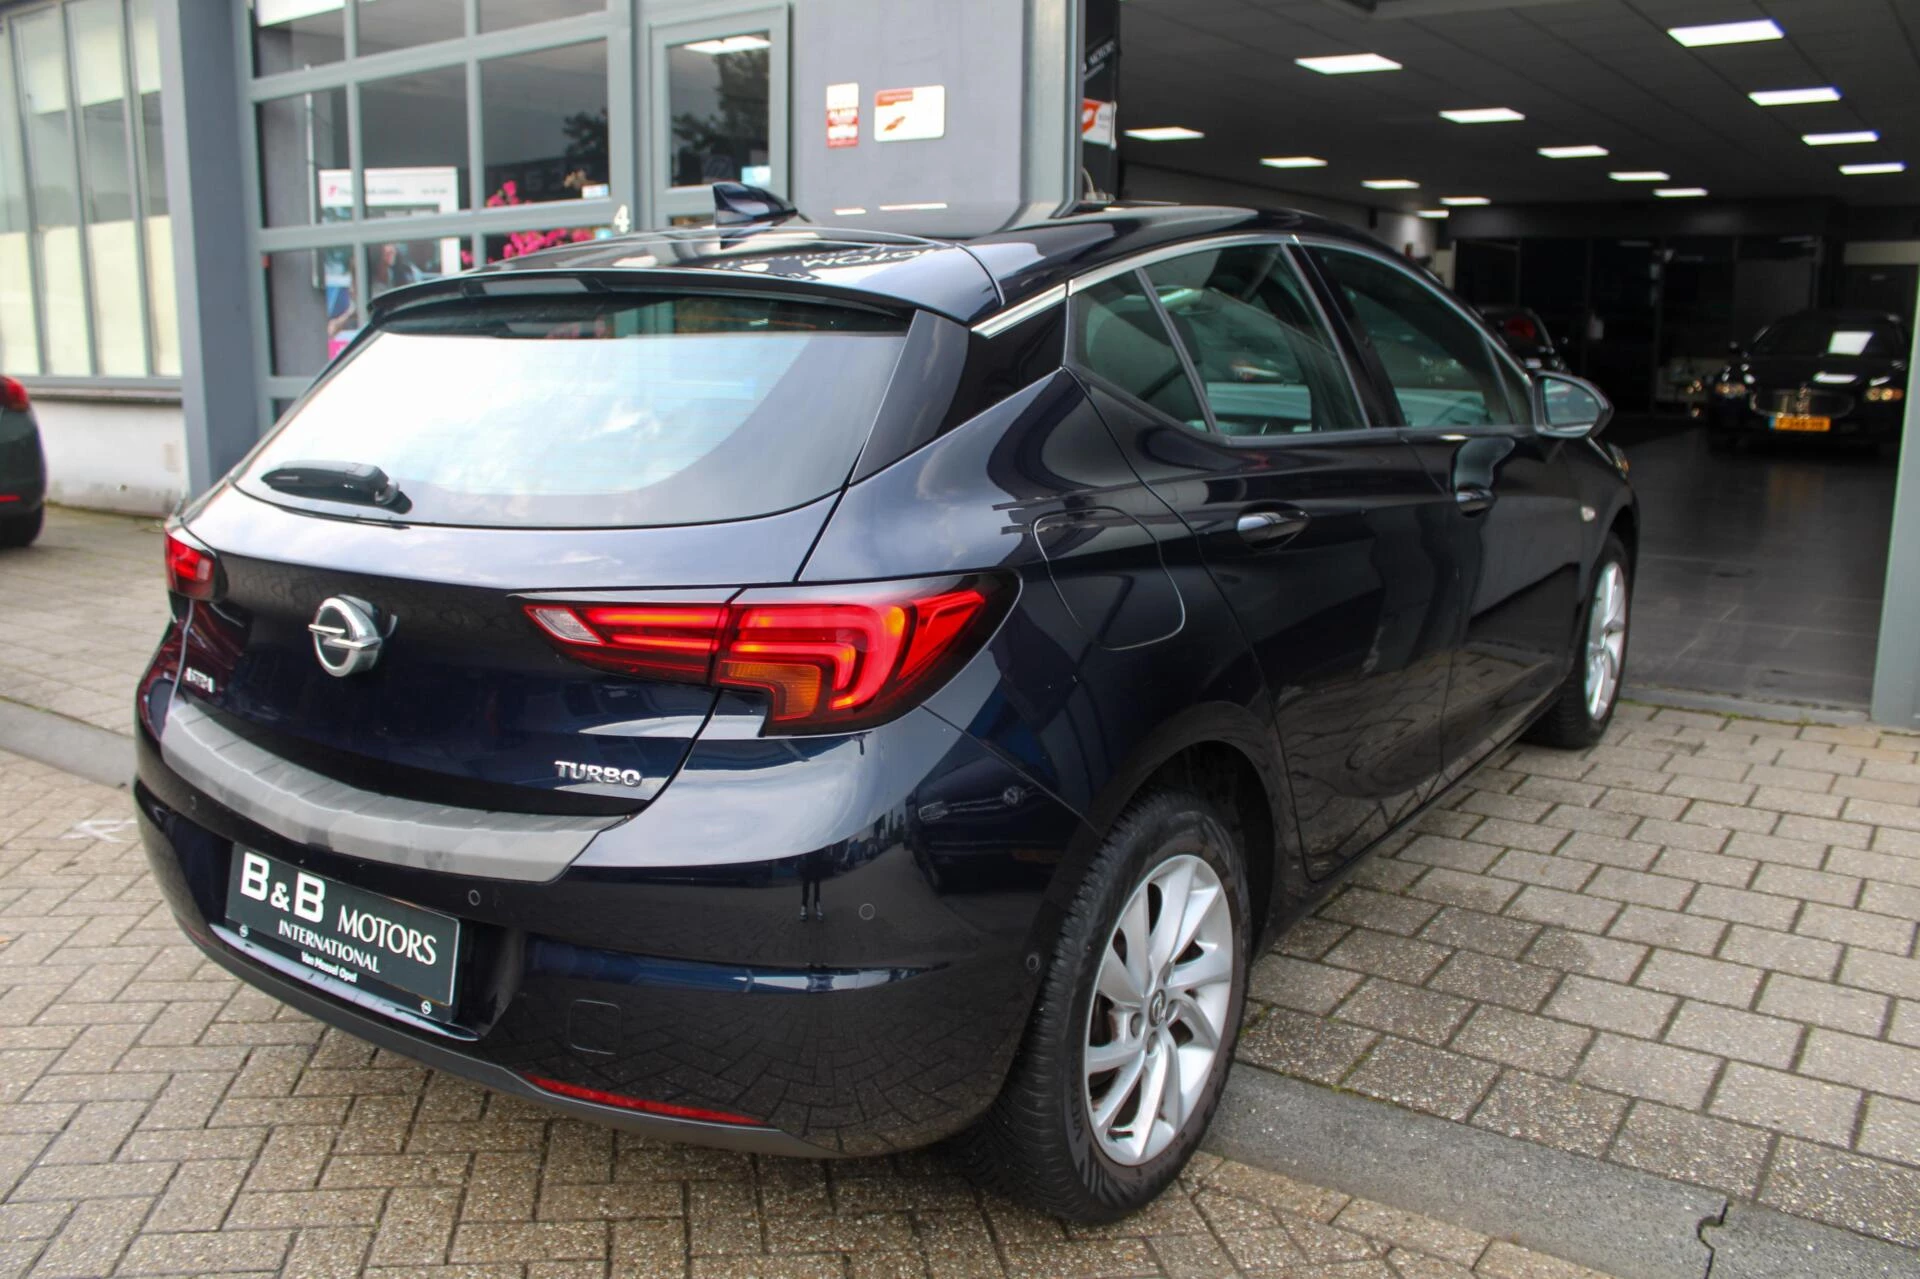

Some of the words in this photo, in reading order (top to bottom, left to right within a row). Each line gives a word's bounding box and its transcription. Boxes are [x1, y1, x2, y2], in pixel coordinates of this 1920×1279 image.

[614, 204, 630, 233] 4
[554, 760, 642, 787] TURBO
[240, 851, 326, 923] B&B
[337, 905, 437, 966] MOTORS
[278, 919, 380, 974] INTERNATIONAL
